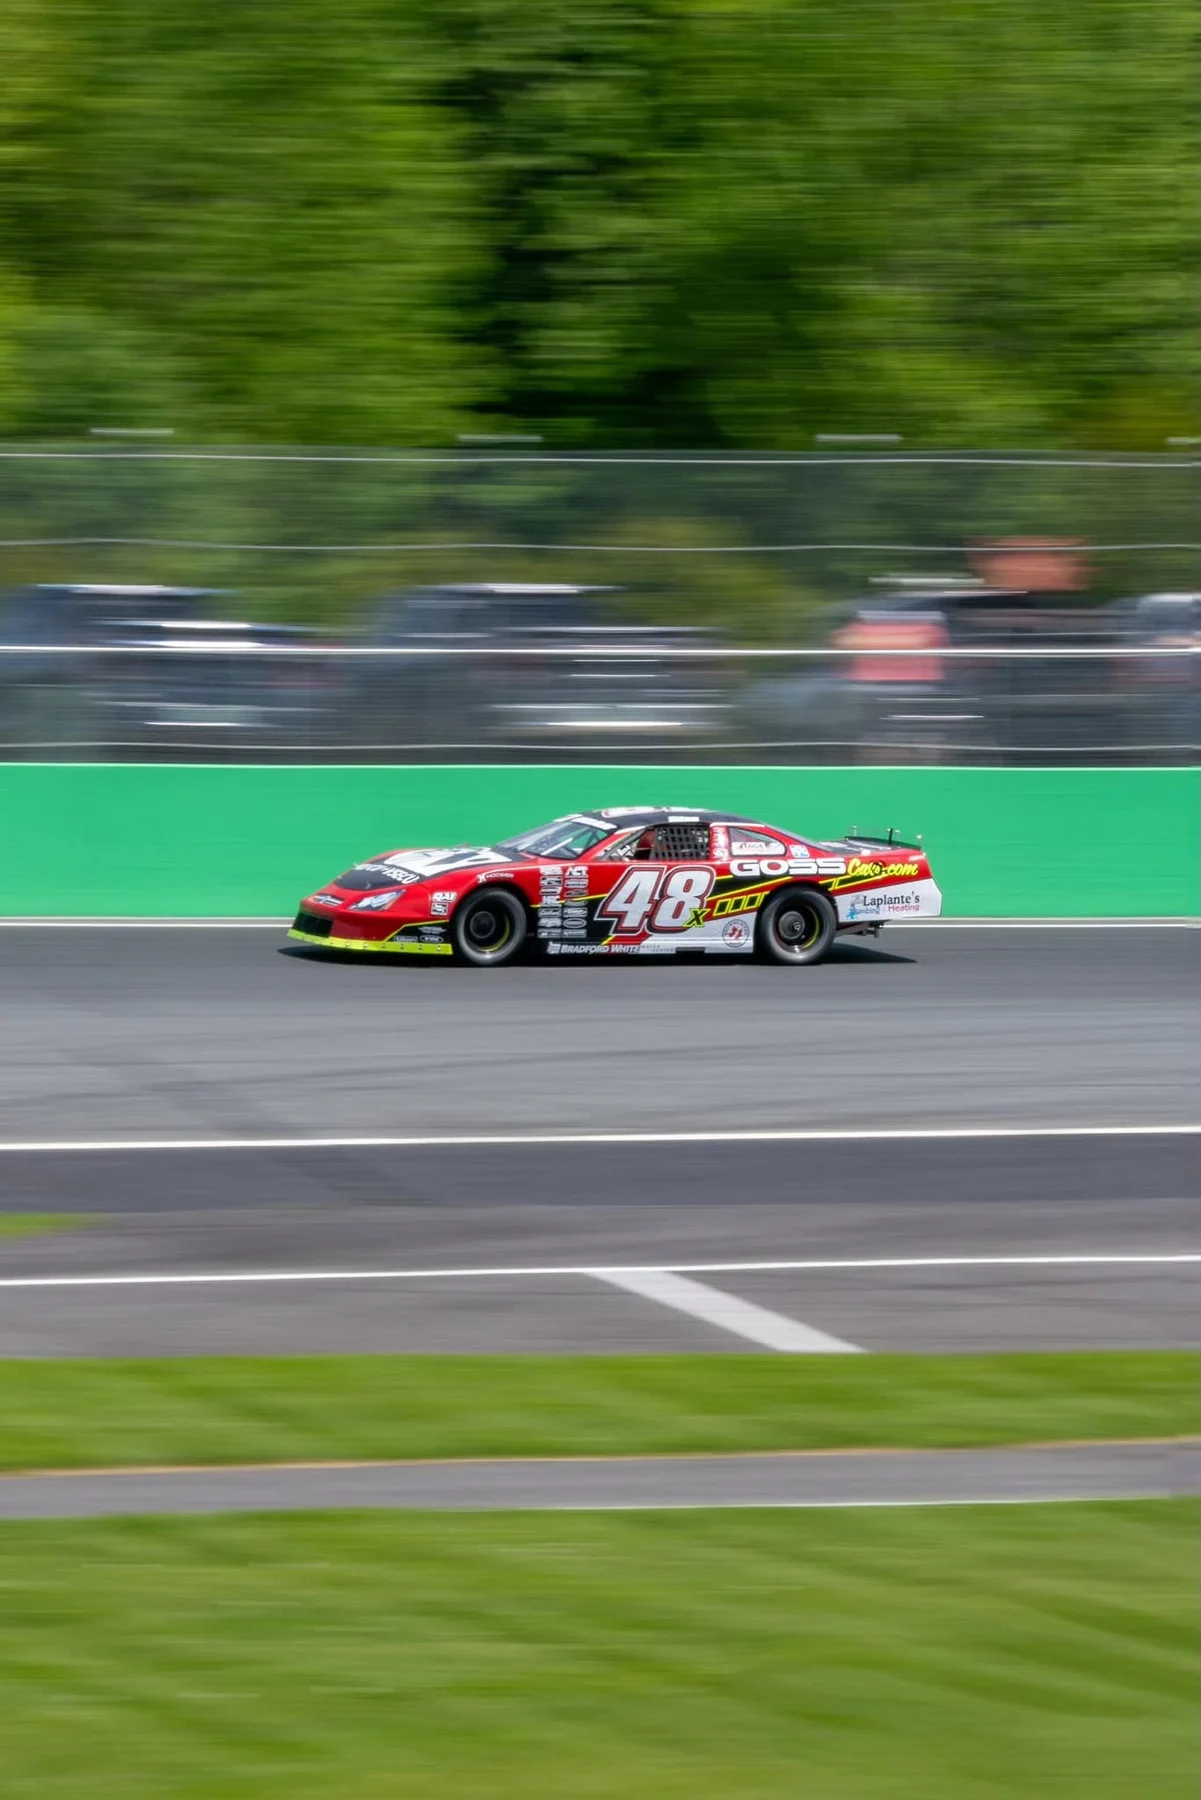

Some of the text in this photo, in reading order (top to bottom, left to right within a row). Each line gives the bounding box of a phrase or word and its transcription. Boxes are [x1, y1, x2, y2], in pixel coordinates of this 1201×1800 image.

[729, 858, 846, 876] GOSS
[594, 864, 717, 936] 48
[863, 891, 920, 908] Laplante's
[888, 904, 920, 912] Heating
[560, 944, 609, 955] BRADFORD
